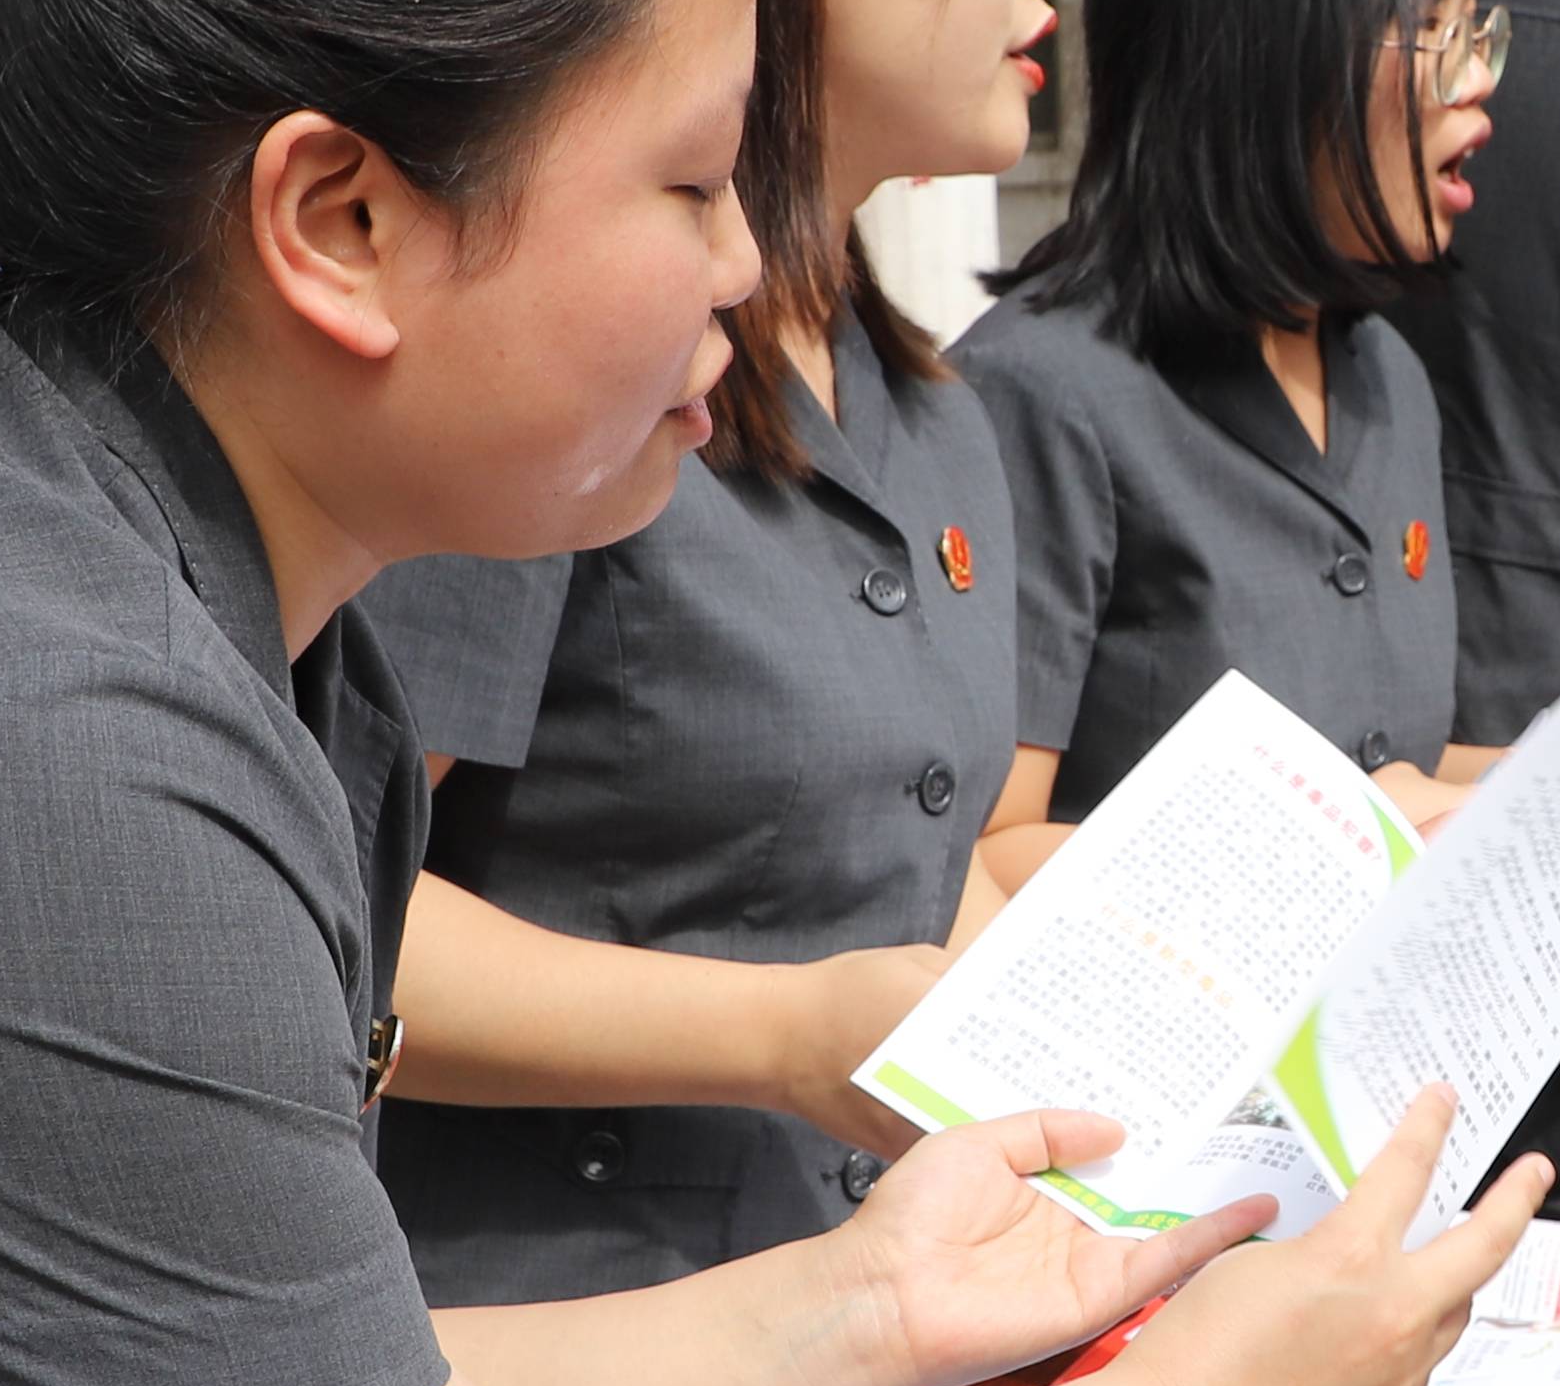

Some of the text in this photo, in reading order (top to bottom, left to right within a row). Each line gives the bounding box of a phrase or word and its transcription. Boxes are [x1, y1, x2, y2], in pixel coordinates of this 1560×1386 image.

[1252, 743, 1383, 863] 什么是毒品犯罪？
